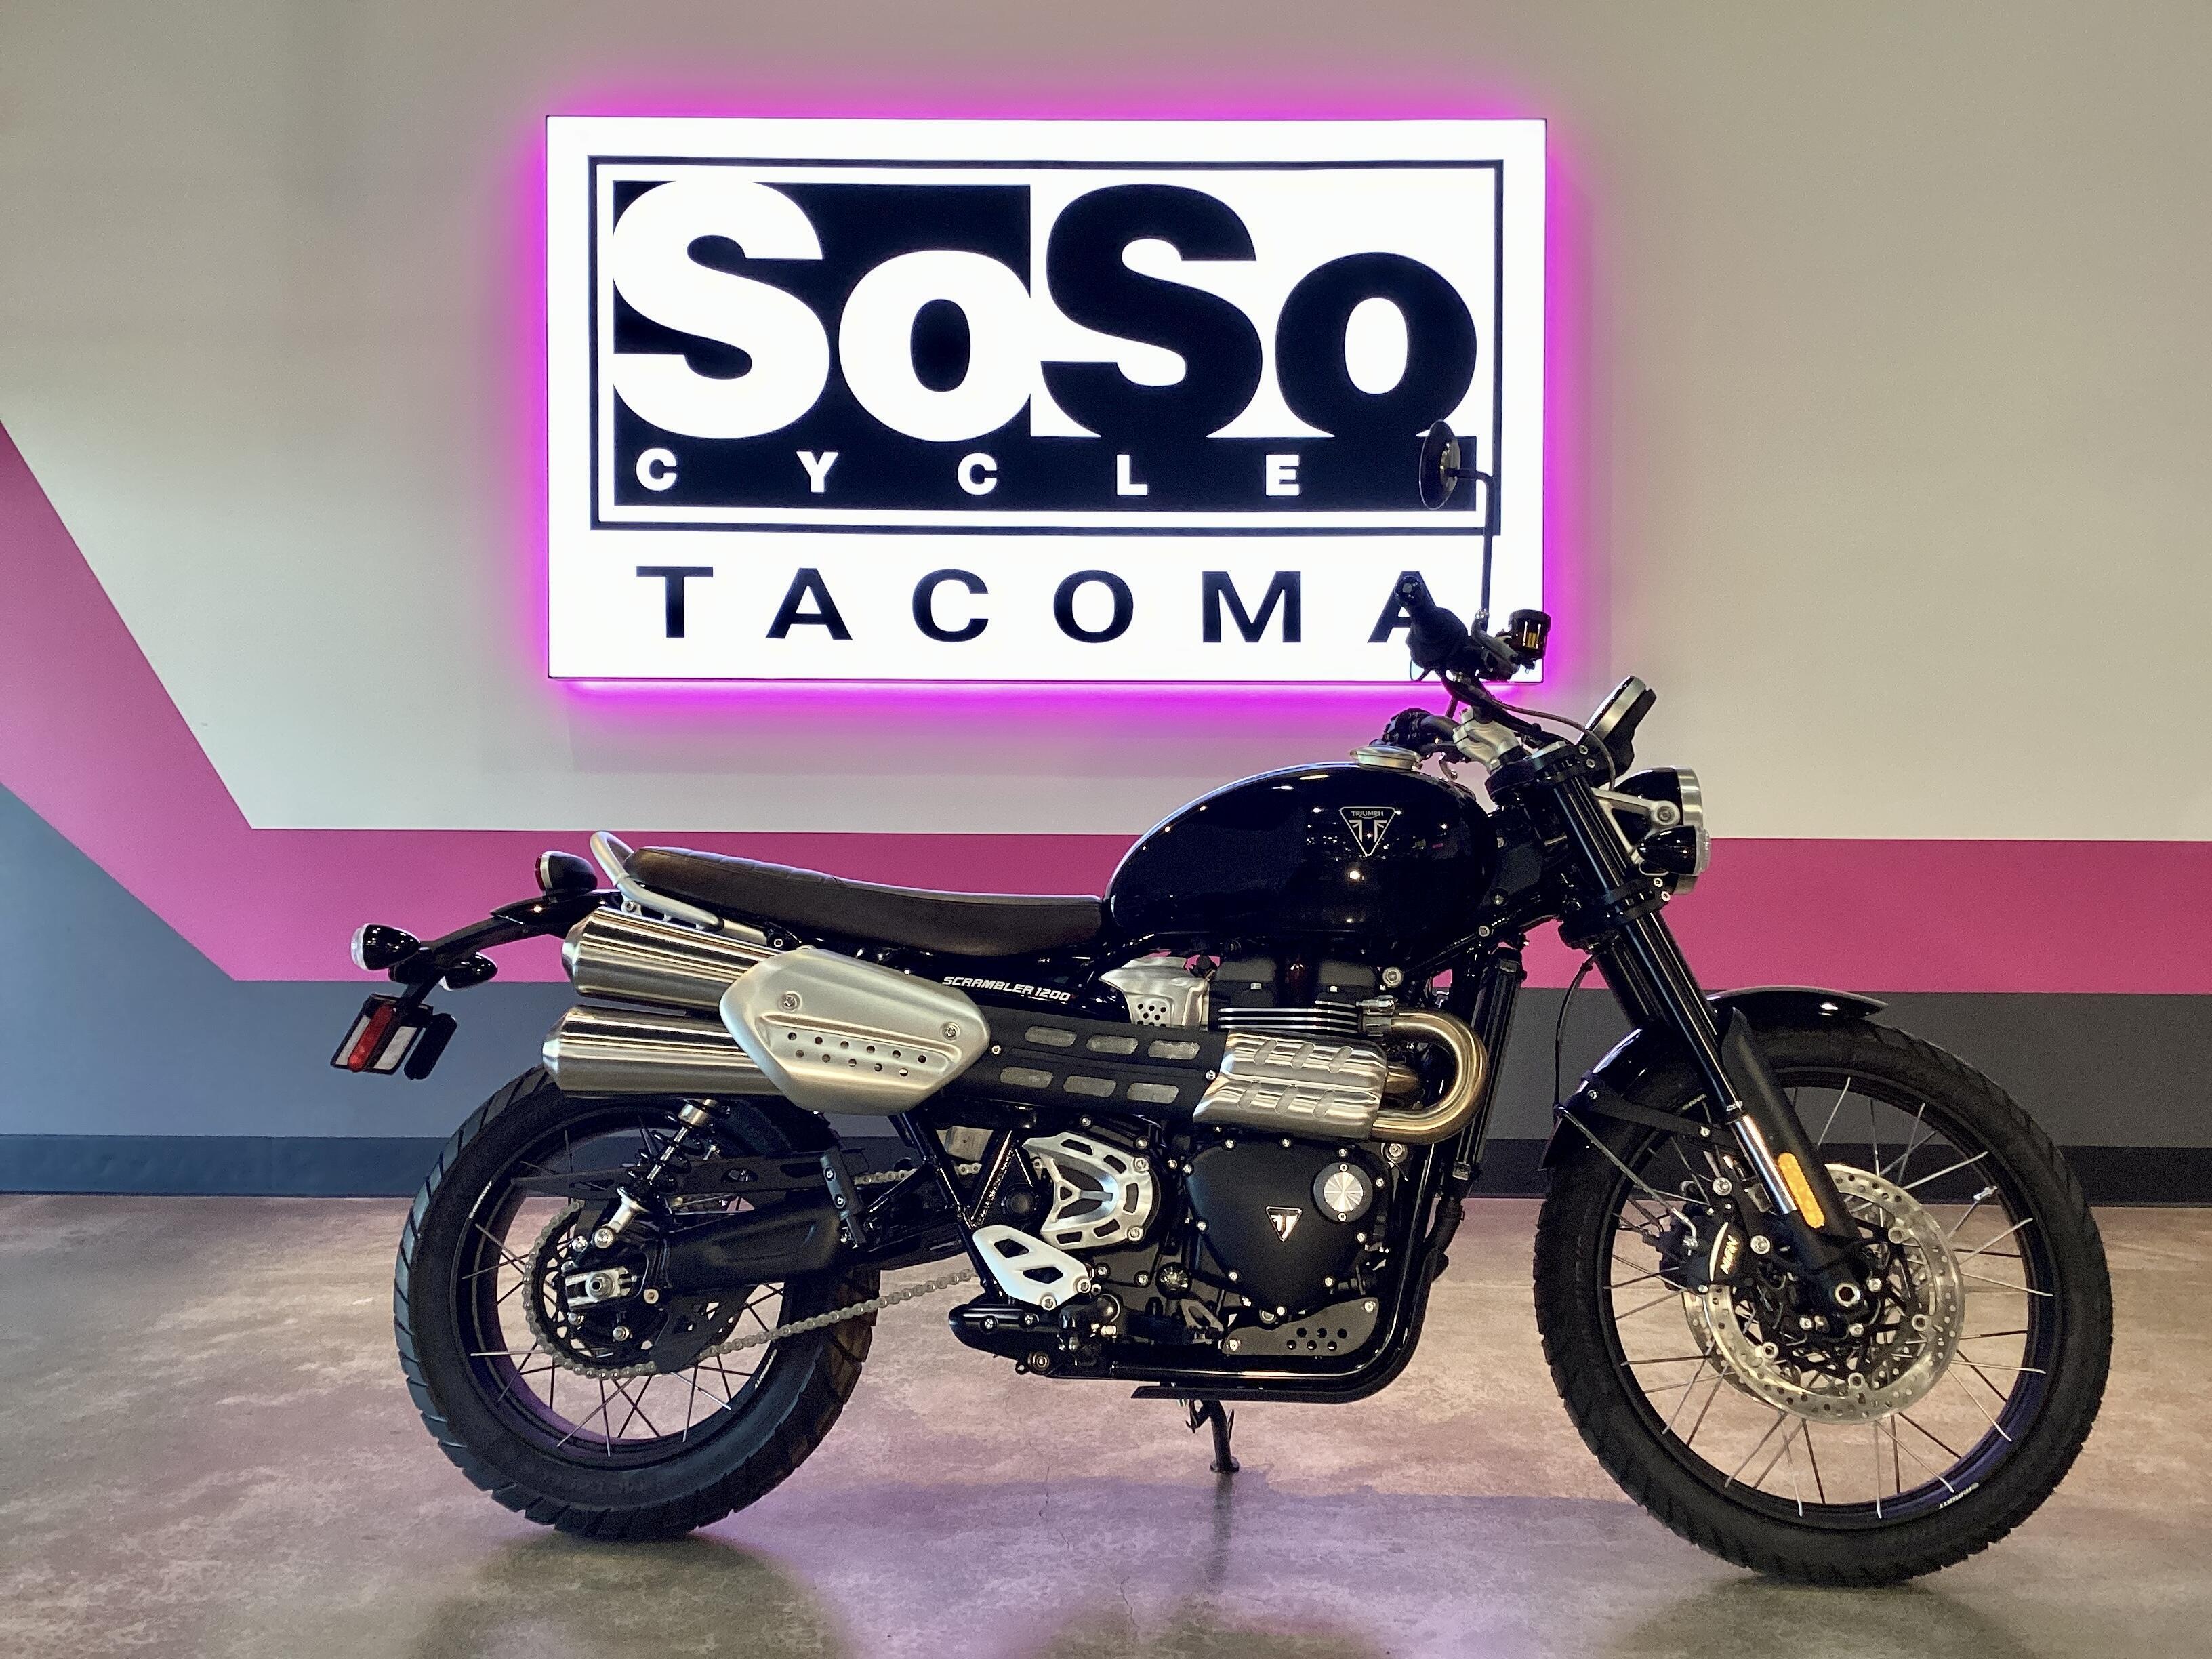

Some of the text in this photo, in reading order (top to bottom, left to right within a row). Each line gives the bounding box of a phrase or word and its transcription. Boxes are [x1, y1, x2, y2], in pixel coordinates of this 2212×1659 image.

[613, 179, 1477, 442] SoSo
[635, 447, 1303, 497] CYCLE
[1350, 809, 1385, 819] TRIUMPH
[942, 976, 1034, 995] SCRAMBLER
[1034, 987, 1071, 1001] 1200
